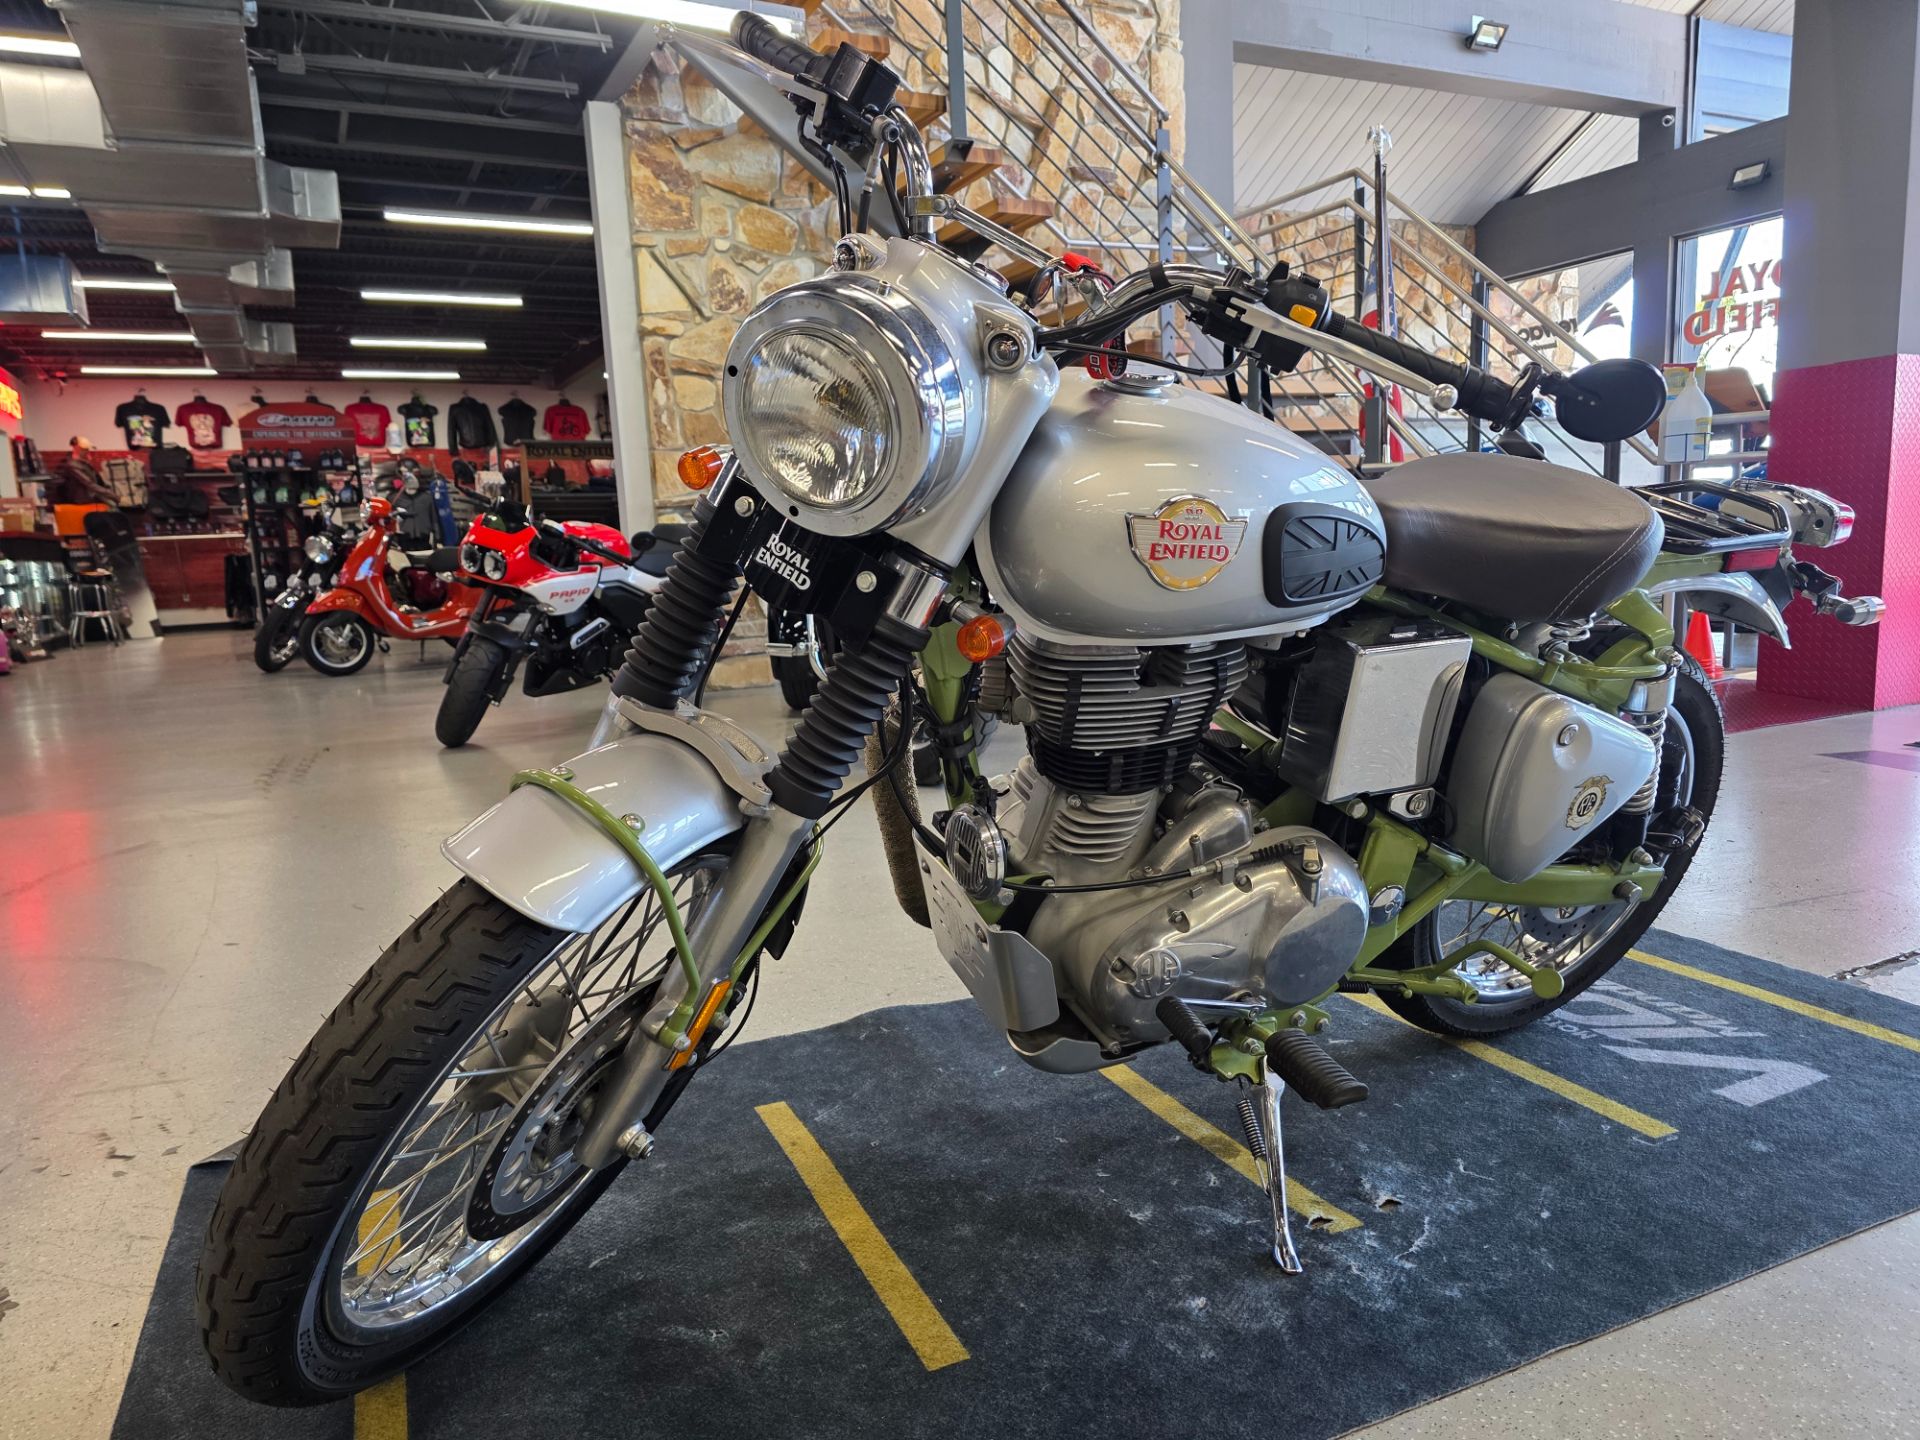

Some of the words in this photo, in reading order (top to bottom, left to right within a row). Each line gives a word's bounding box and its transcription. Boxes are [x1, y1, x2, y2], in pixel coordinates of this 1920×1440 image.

[253, 430, 290, 438] EXPERIENCE
[293, 430, 305, 438] THE
[307, 430, 342, 438] DIFFERENCE
[527, 447, 565, 457] ROYAL
[571, 447, 614, 458] ENFIEL
[1159, 519, 1223, 541] ROYAL
[766, 534, 811, 574] ROYAL
[1149, 543, 1230, 563] ENFIELD
[755, 547, 811, 591] ENFIELD
[549, 587, 591, 600] PAPIO
